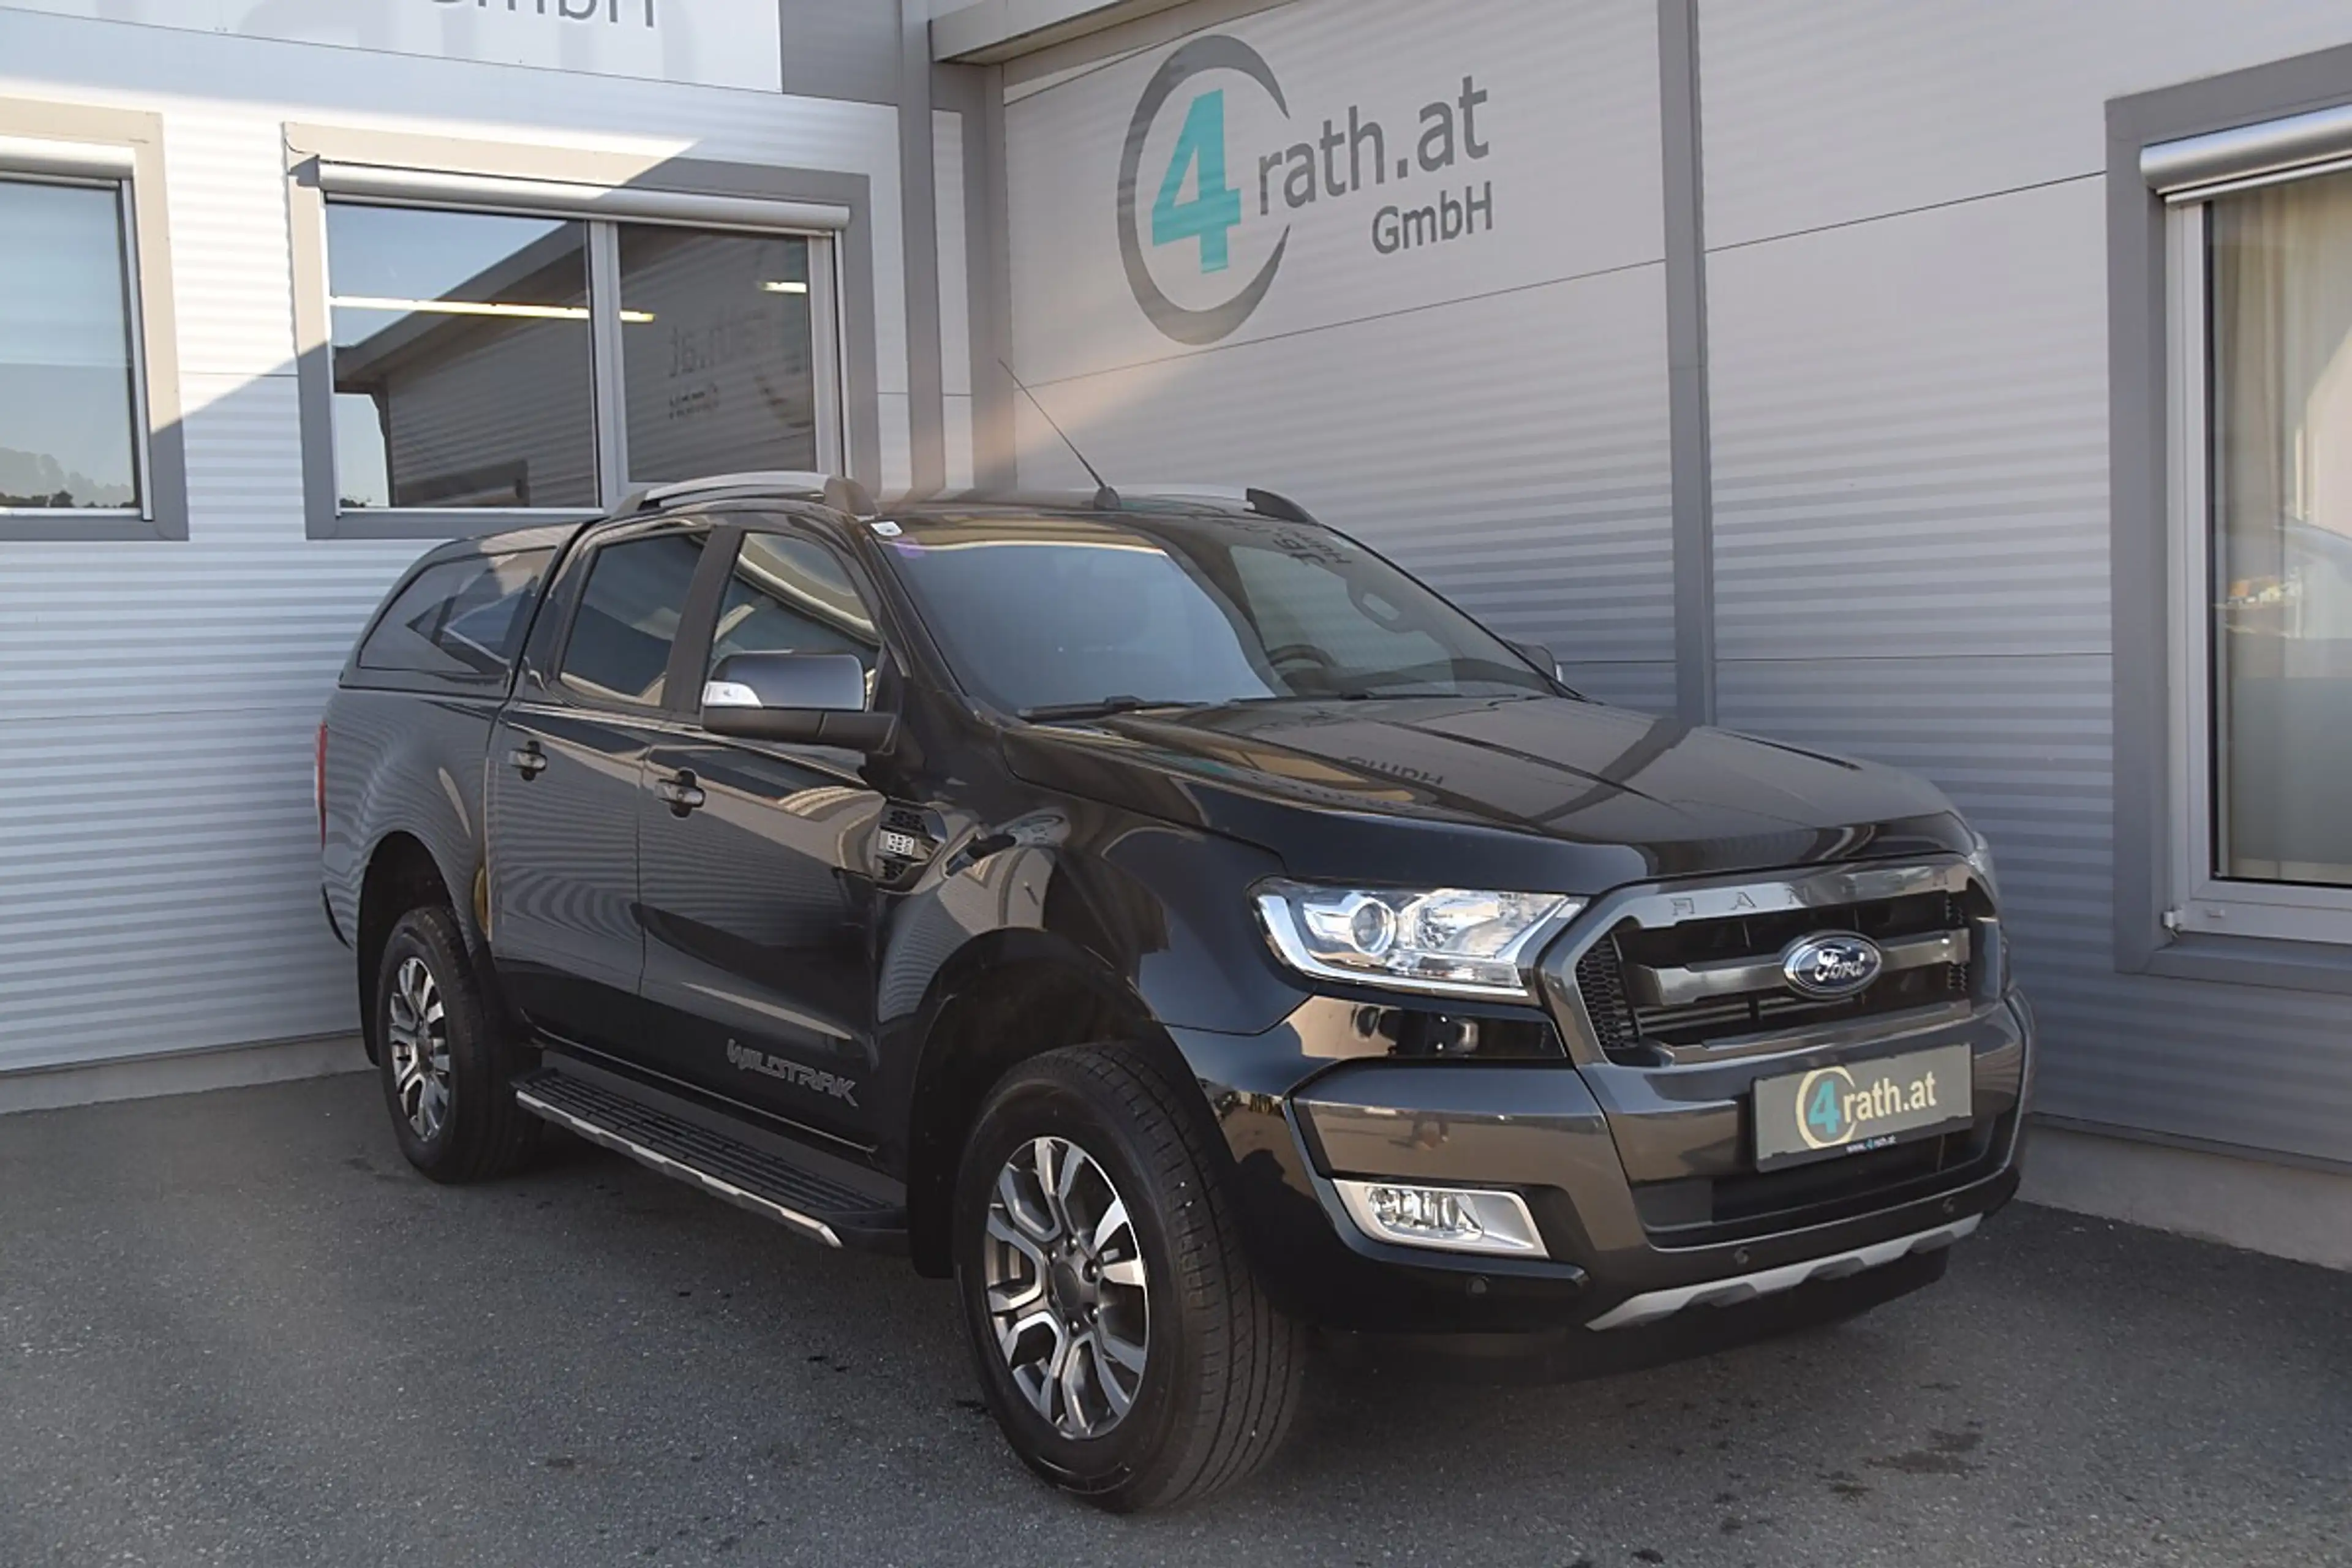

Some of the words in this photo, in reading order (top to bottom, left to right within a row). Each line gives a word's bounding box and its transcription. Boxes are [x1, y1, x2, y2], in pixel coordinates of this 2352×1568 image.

[1371, 181, 1493, 254] GmbH
[1814, 946, 1866, 982] Ford
[726, 1038, 859, 1107] WILDTRAK
